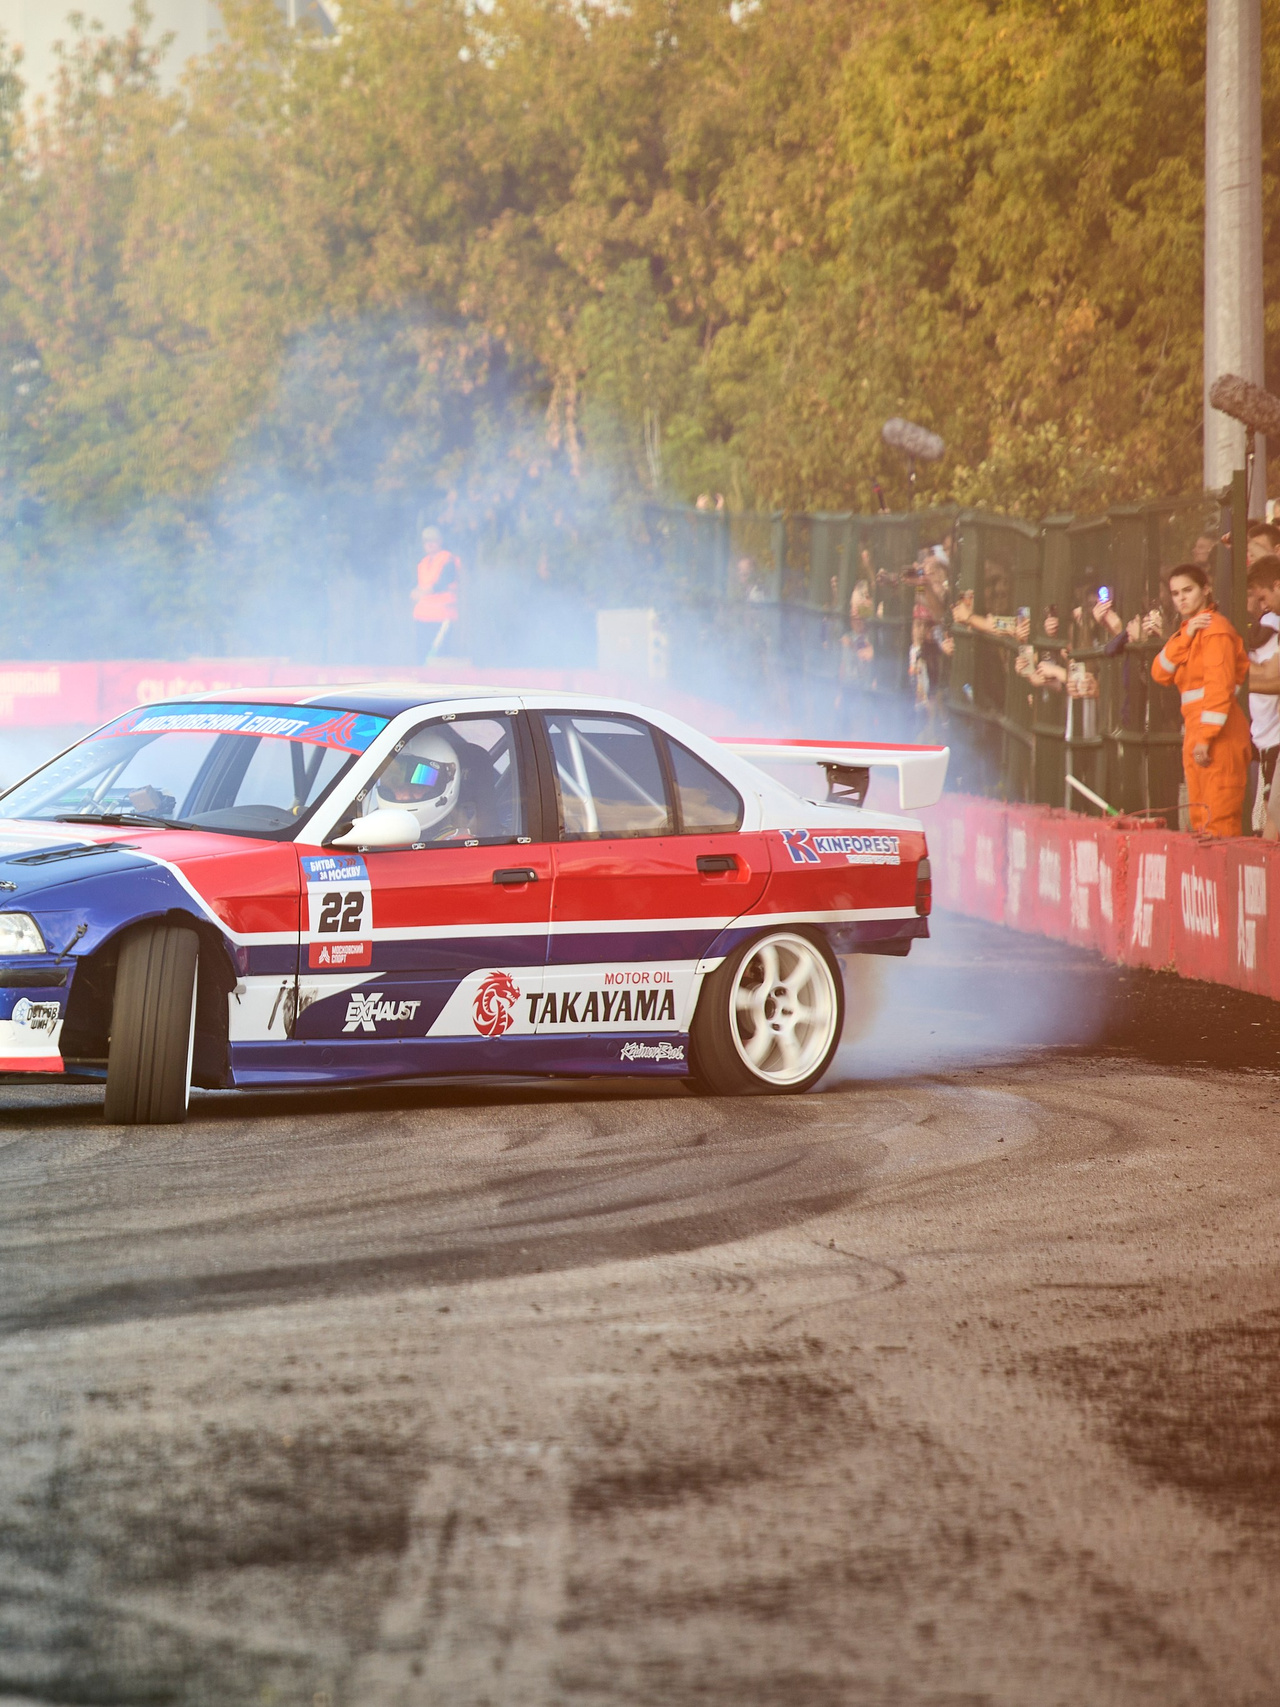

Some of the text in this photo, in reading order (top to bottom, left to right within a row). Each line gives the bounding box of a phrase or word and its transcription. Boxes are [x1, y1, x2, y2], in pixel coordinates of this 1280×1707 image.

[130, 711, 310, 737] МОСКОВСКИЙ СПОРТ
[813, 836, 899, 854] KINFOREST
[310, 858, 336, 872] БИТВА
[320, 866, 361, 881] ЗА МОСКВУ
[318, 891, 365, 933] 22
[604, 971, 674, 985] MOTOR OIL
[342, 992, 421, 1032] EXHAUST
[526, 989, 676, 1025] TAKAYAMA
